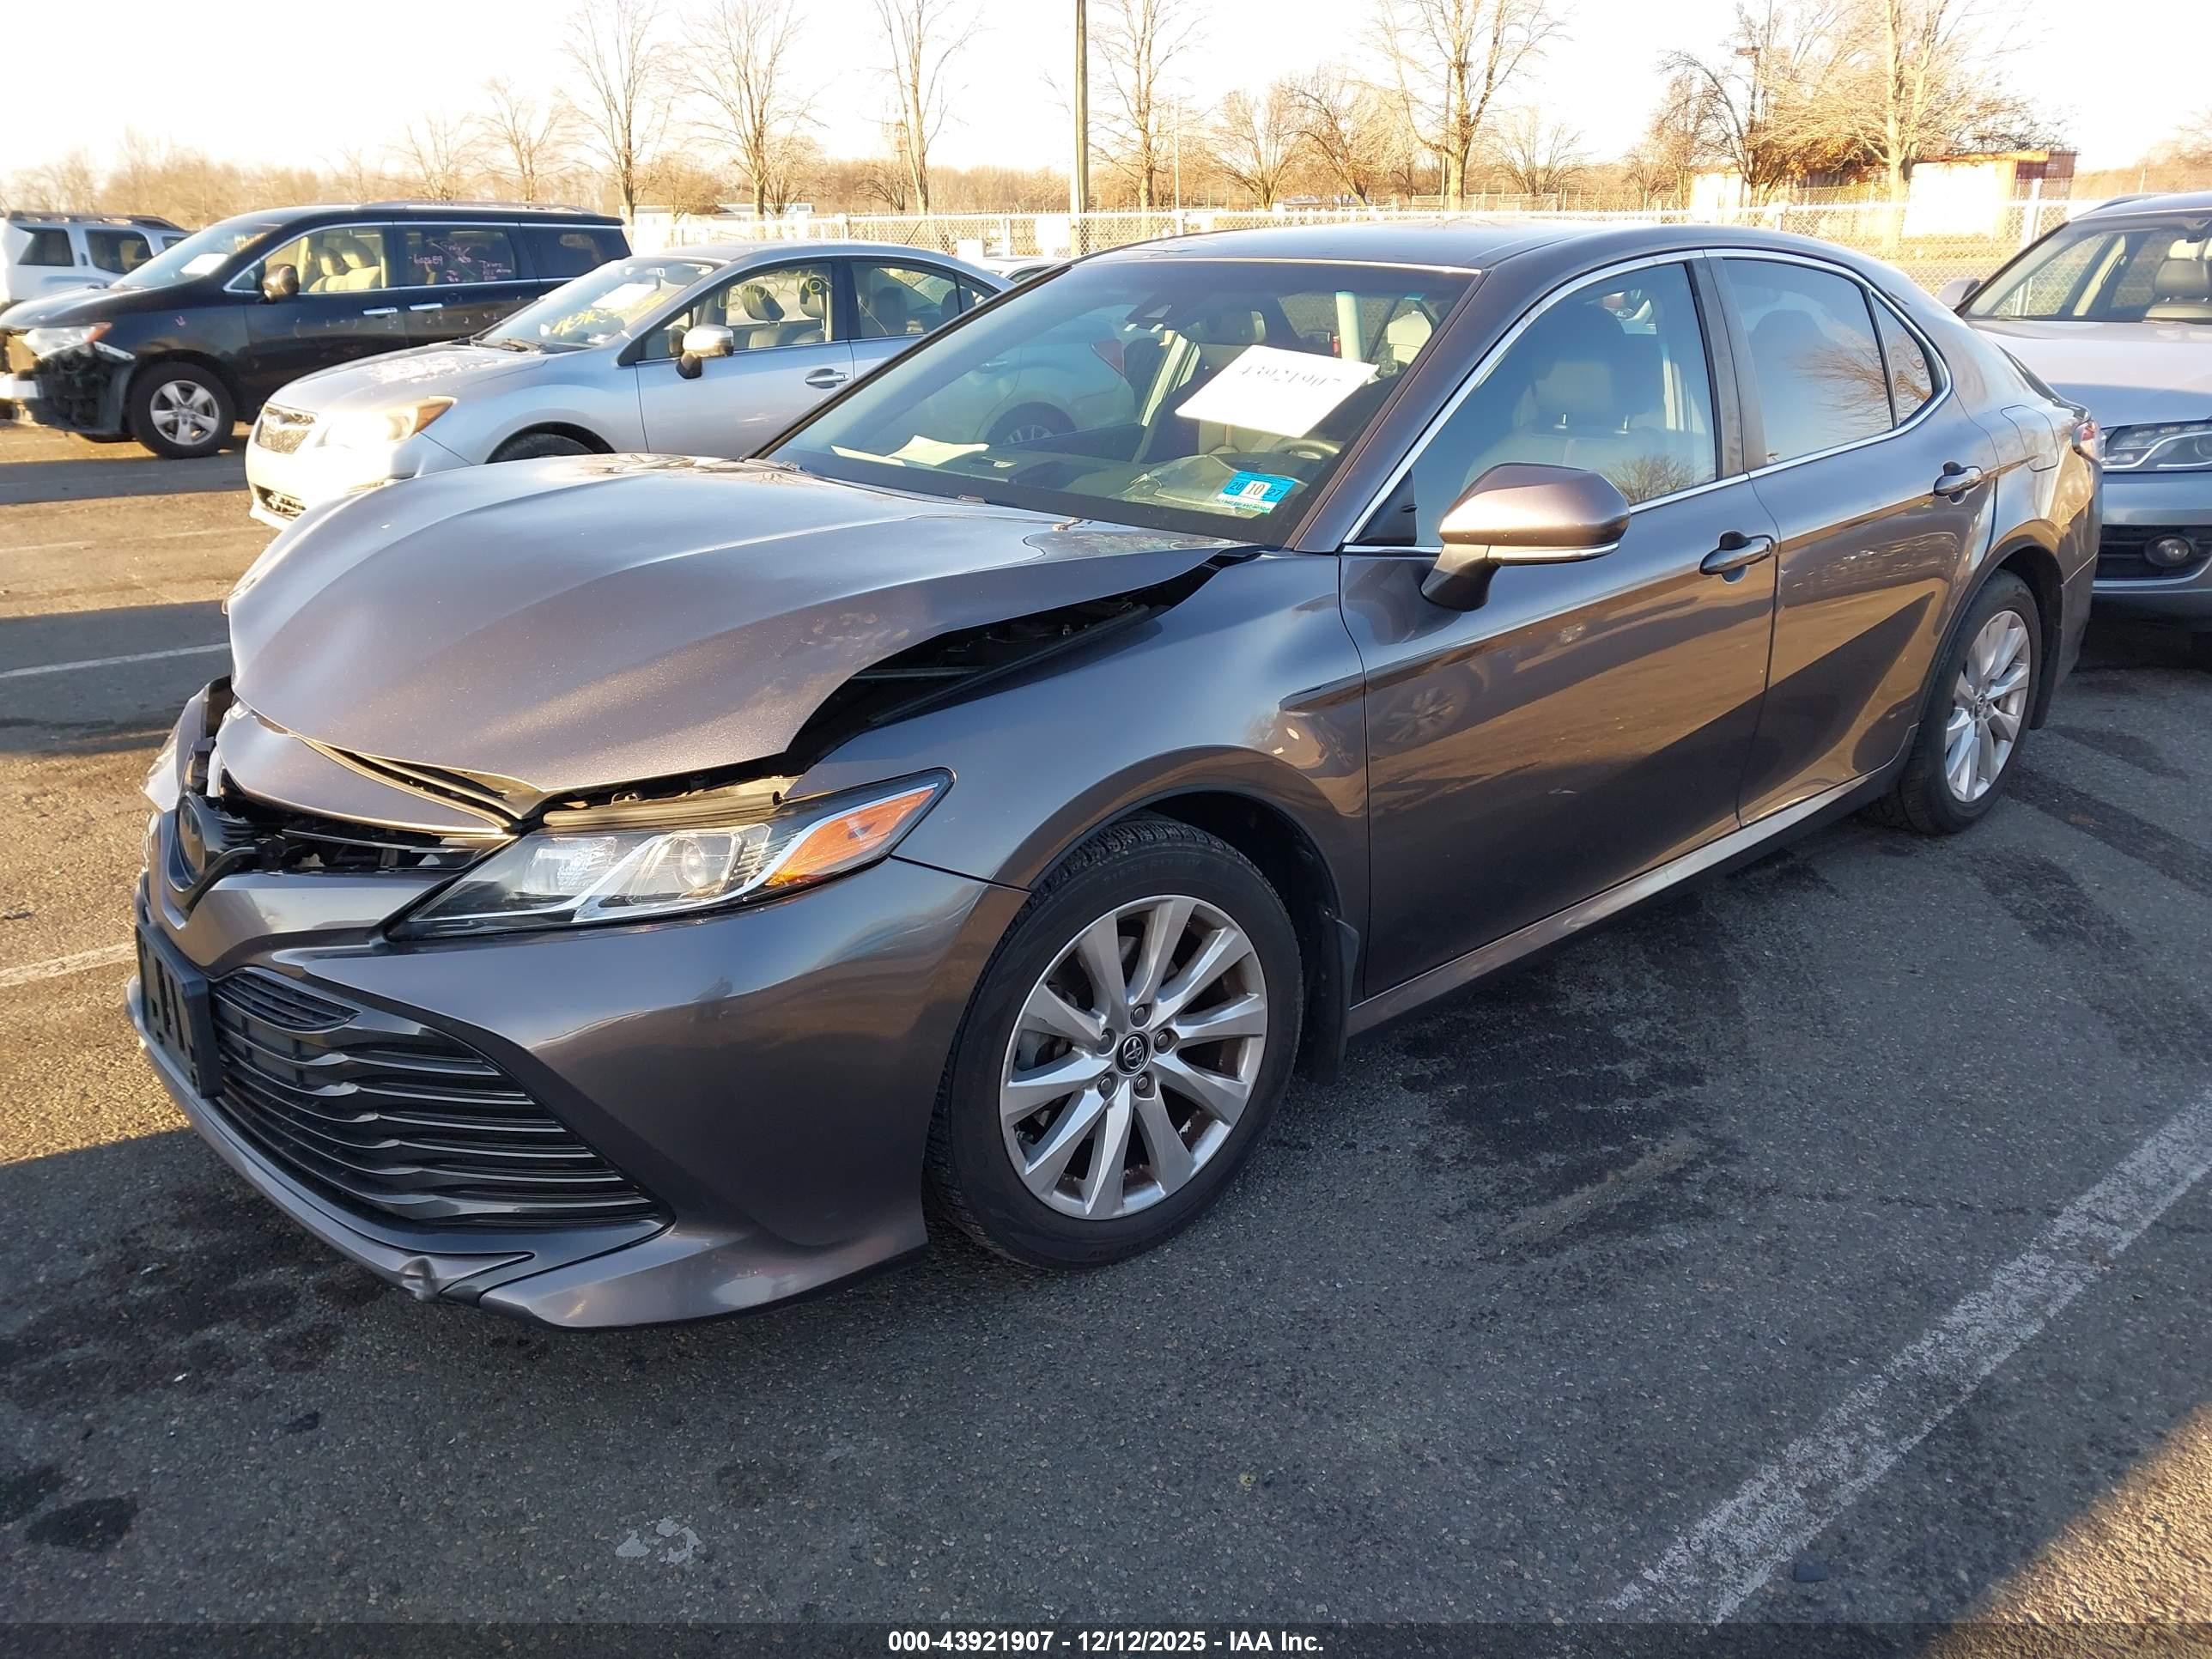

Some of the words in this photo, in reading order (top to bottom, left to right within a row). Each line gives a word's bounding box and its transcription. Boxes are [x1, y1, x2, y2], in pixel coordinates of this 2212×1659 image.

[1229, 481, 1245, 491] 20
[1246, 483, 1266, 495] 10
[1267, 488, 1283, 497] 27
